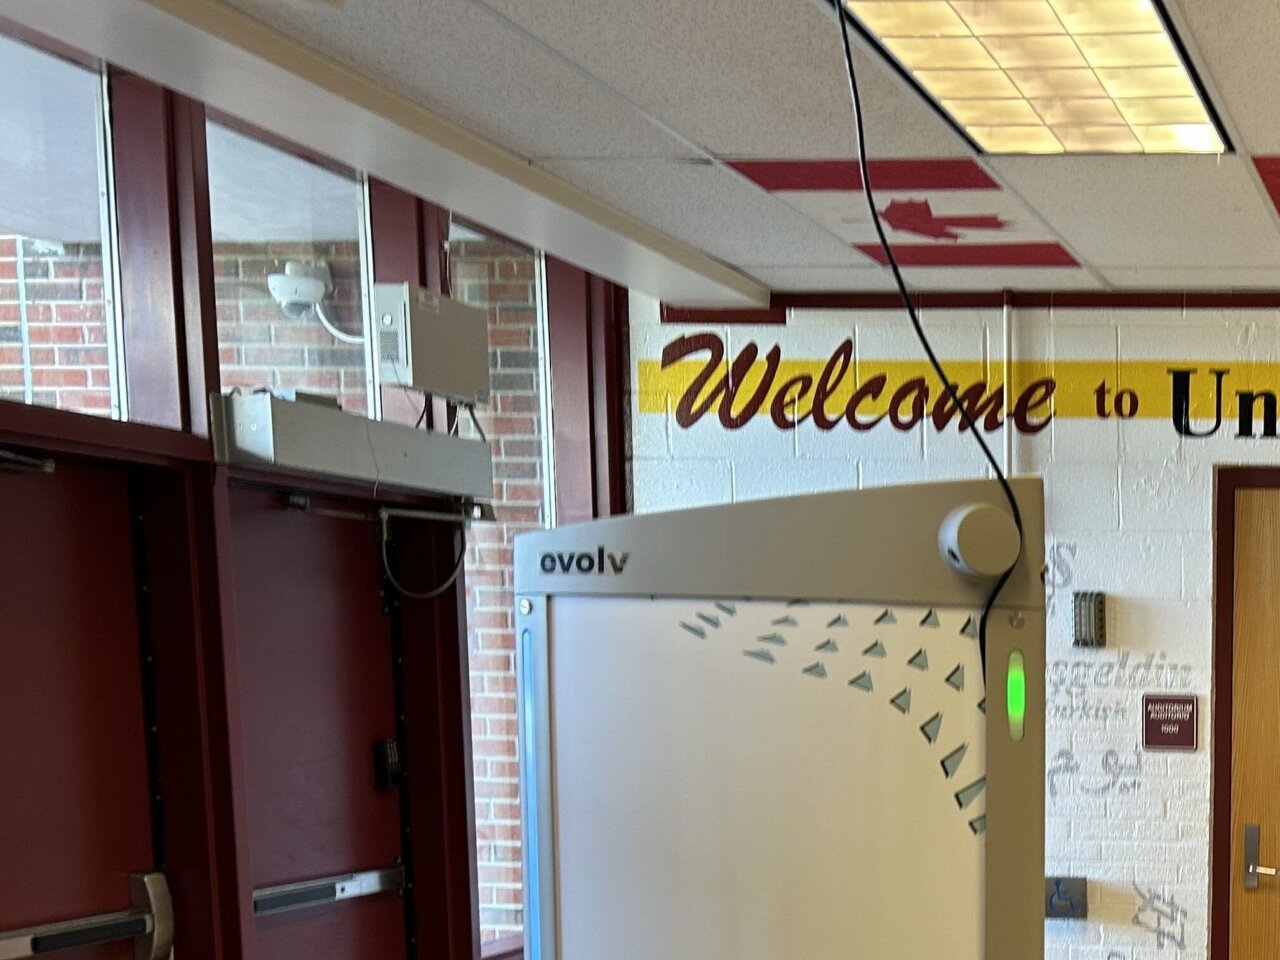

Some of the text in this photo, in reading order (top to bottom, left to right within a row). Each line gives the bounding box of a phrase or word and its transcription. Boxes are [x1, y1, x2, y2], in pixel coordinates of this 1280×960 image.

[660, 329, 1058, 435] Welcome
[1093, 378, 1140, 420] to
[539, 545, 630, 574] evolv
[1147, 702, 1193, 713] AUDITORIUM
